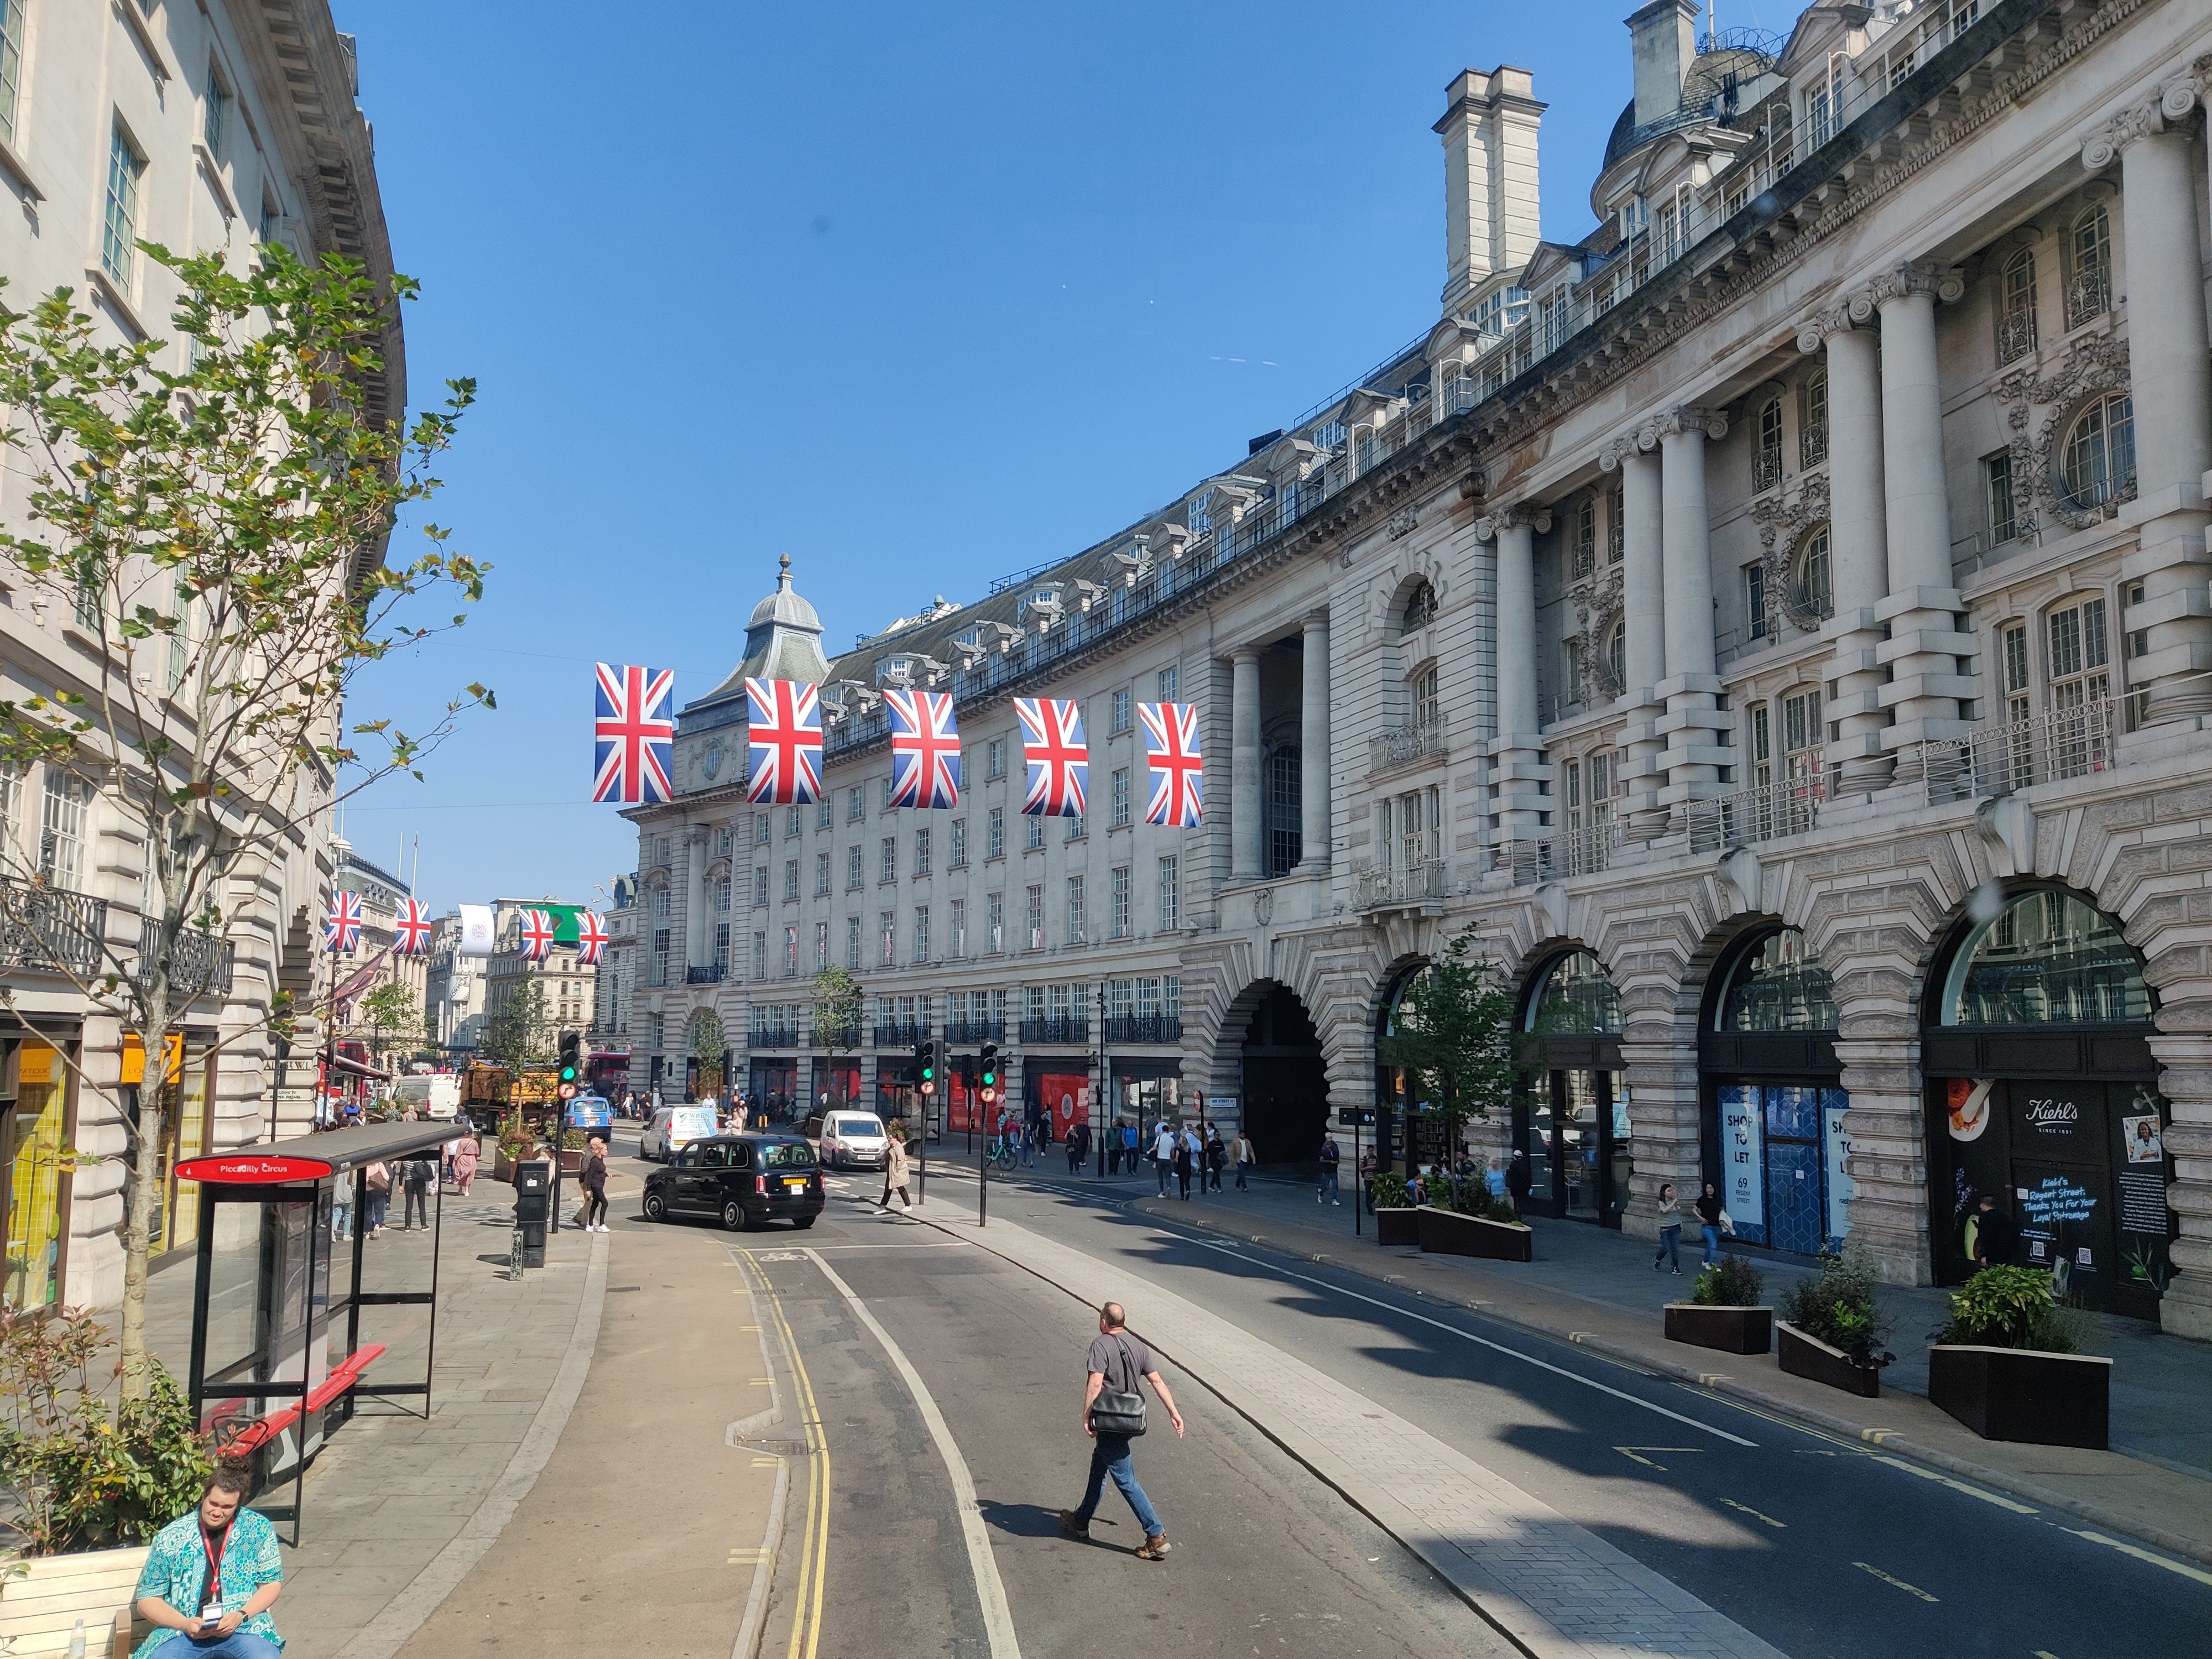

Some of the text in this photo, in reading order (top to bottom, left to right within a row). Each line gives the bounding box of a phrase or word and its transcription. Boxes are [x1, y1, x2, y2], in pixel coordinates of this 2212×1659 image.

[2026, 1099, 2078, 1120] Kiehl's
[1728, 1115, 1753, 1127] SHOP
[1832, 1121, 1846, 1134] SH
[1735, 1133, 1747, 1145] TO
[1734, 1151, 1749, 1164] LET
[261, 1165, 288, 1173] Circus
[1738, 1177, 1747, 1188] 69
[2030, 1189, 2057, 1201] Regent
[2023, 1198, 2097, 1212] Thanks You For Your
[2033, 1212, 2051, 1223] Loyal
